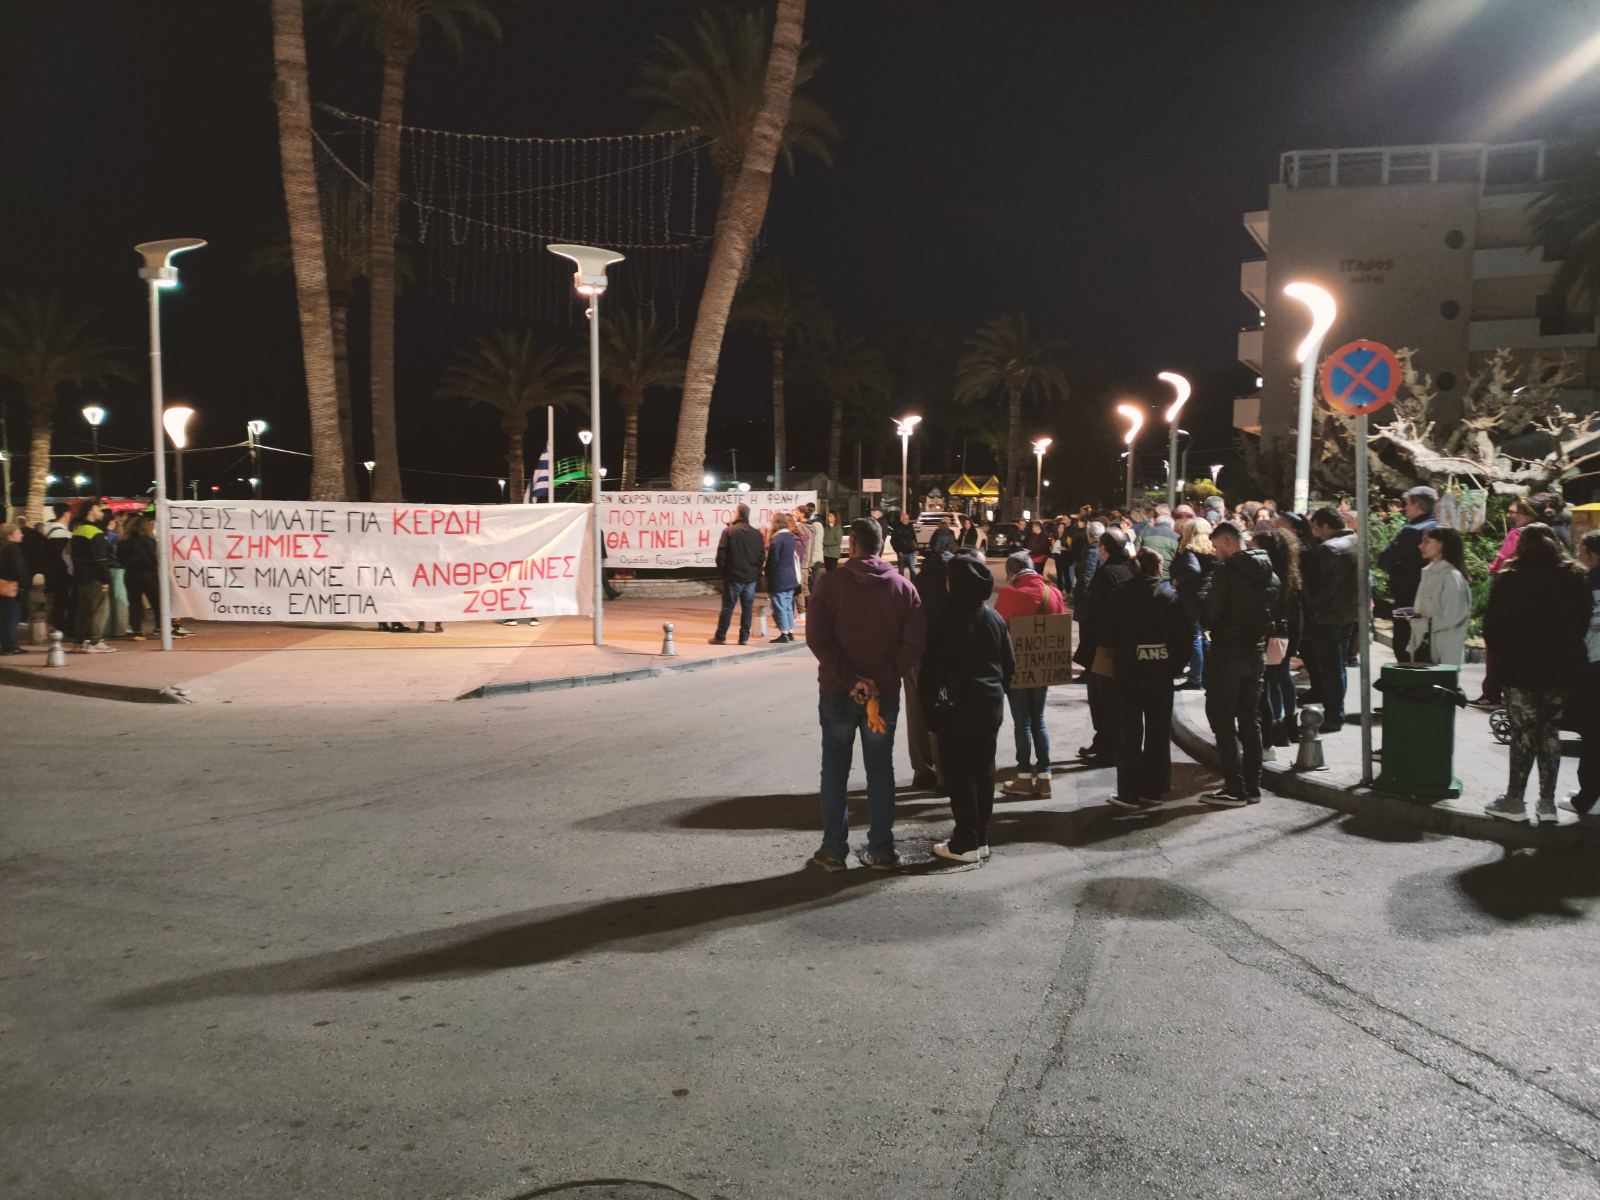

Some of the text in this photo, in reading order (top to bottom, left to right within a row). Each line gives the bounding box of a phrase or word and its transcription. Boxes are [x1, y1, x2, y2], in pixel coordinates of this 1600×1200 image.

[750, 494, 758, 505] Η
[168, 506, 481, 536] ΕΣΕΙΣ ΜΙΛΑΤΕ ΓΙΑ ΚΕΡΔΗ
[608, 510, 676, 527] ΠΟΤΑΜΙ
[682, 510, 706, 526] ΝΑ
[170, 534, 330, 561] ΚΑΙ ΖΗΜΙΕΣ
[606, 528, 710, 550] ΘΑ ΓΙΝΕΙ Η
[173, 555, 577, 589] ΕΜΕΙΣ ΜΙΛΑΜΕ ΓΙΑ ΑΝΘΡΩΠΙΝΕΣ
[208, 591, 379, 616] Φοιτητές ΕΛΜΕΠΑ
[462, 587, 534, 614] ΖΩΕΣ
[1034, 615, 1047, 634] Η
[1014, 634, 1065, 652] ΑΝΟΙΞΗ
